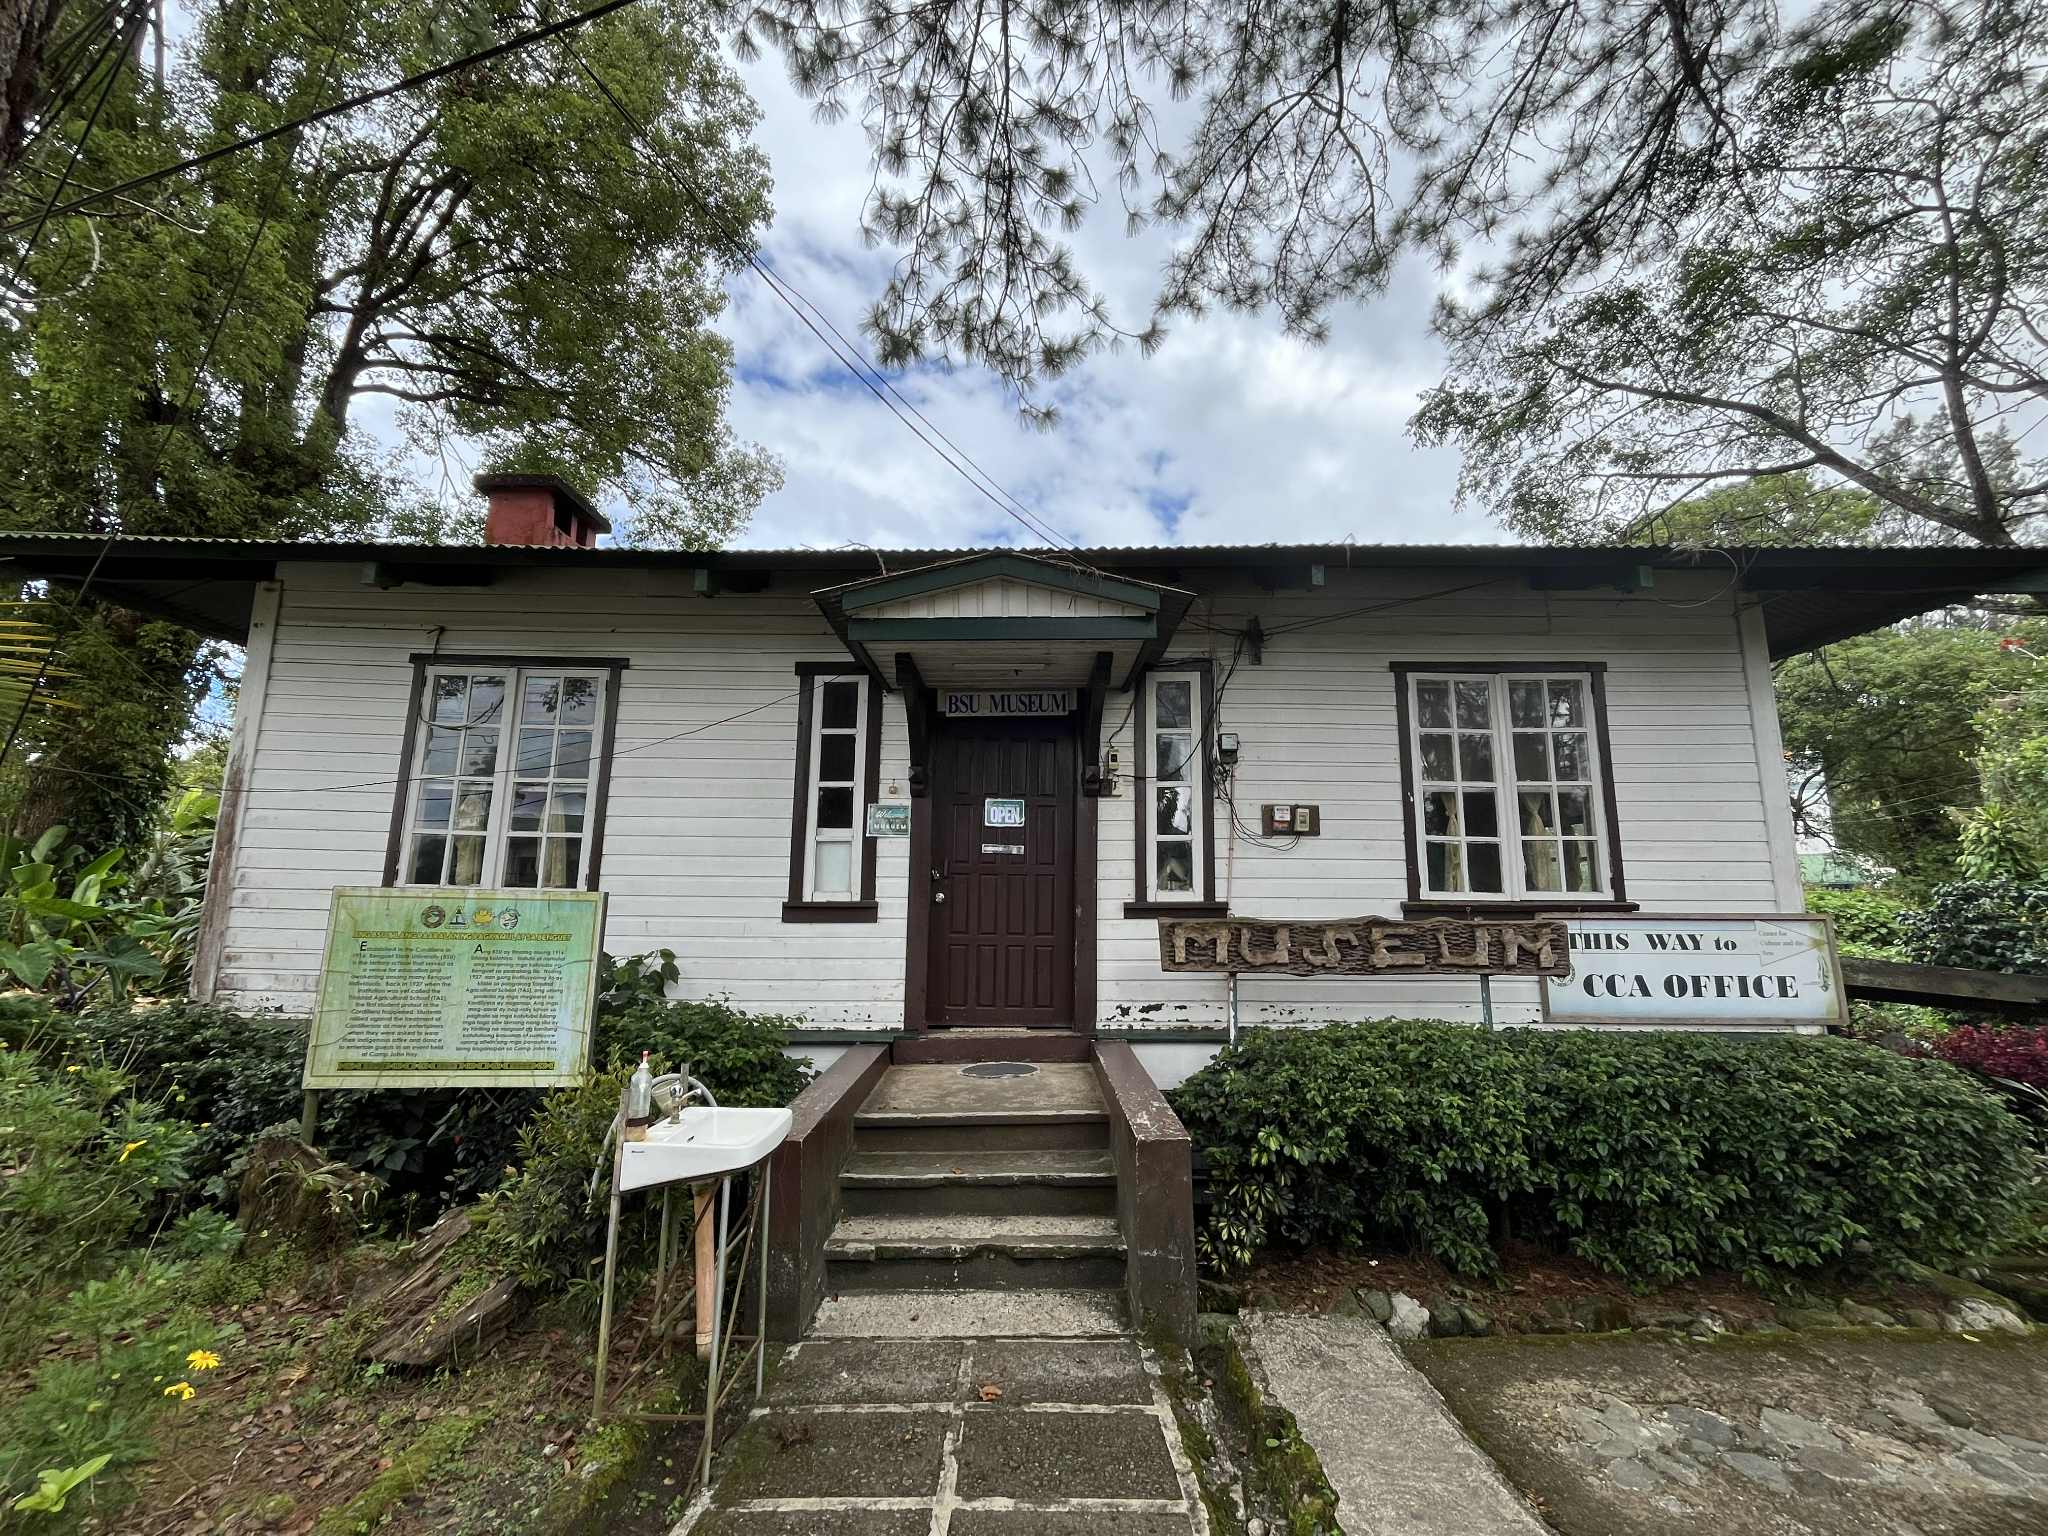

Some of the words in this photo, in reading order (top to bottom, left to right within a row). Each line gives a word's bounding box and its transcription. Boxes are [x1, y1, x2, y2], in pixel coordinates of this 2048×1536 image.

[948, 694, 981, 713] BSU
[989, 694, 1067, 713] MUSEUM
[990, 806, 1020, 823] OPEN
[1171, 926, 1560, 969] MUSEUM
[1568, 932, 1631, 951] THIS
[1645, 933, 1704, 951] WAY
[1713, 936, 1738, 951] to
[1582, 973, 1654, 998] CCA
[1663, 974, 1799, 998] OFFICE
